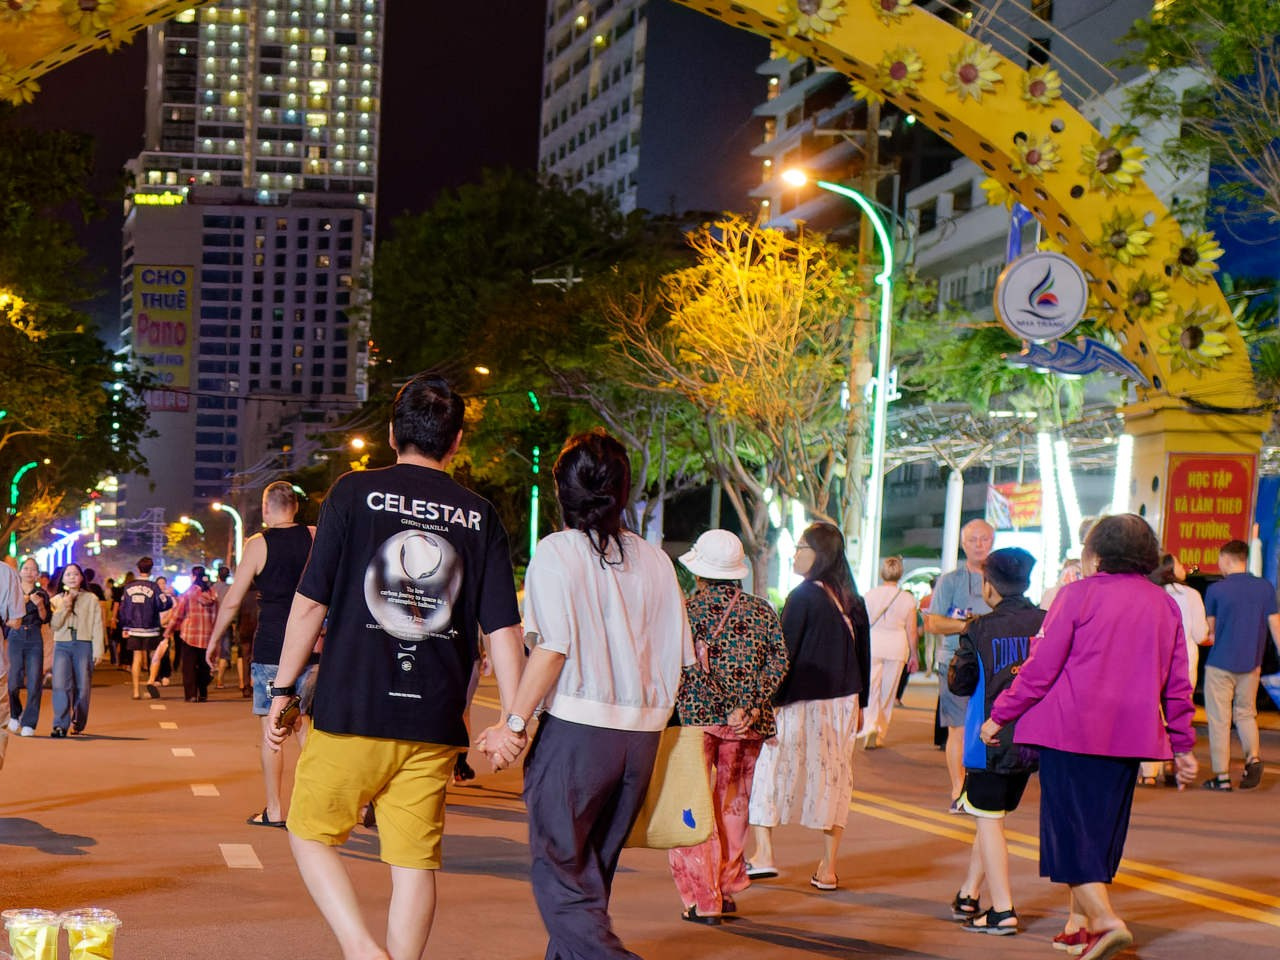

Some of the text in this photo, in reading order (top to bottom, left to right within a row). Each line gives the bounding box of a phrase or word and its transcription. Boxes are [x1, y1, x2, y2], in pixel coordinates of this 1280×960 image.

[141, 269, 187, 285] CHO
[141, 289, 188, 310] THUÊ
[137, 312, 187, 347] Pano
[1187, 469, 1232, 491] HỌC TẬP
[366, 491, 482, 531] CELESTAR
[1174, 494, 1242, 514] VÀ LÀM THEO
[421, 523, 449, 532] VANILLA
[1180, 522, 1193, 539] TƯ
